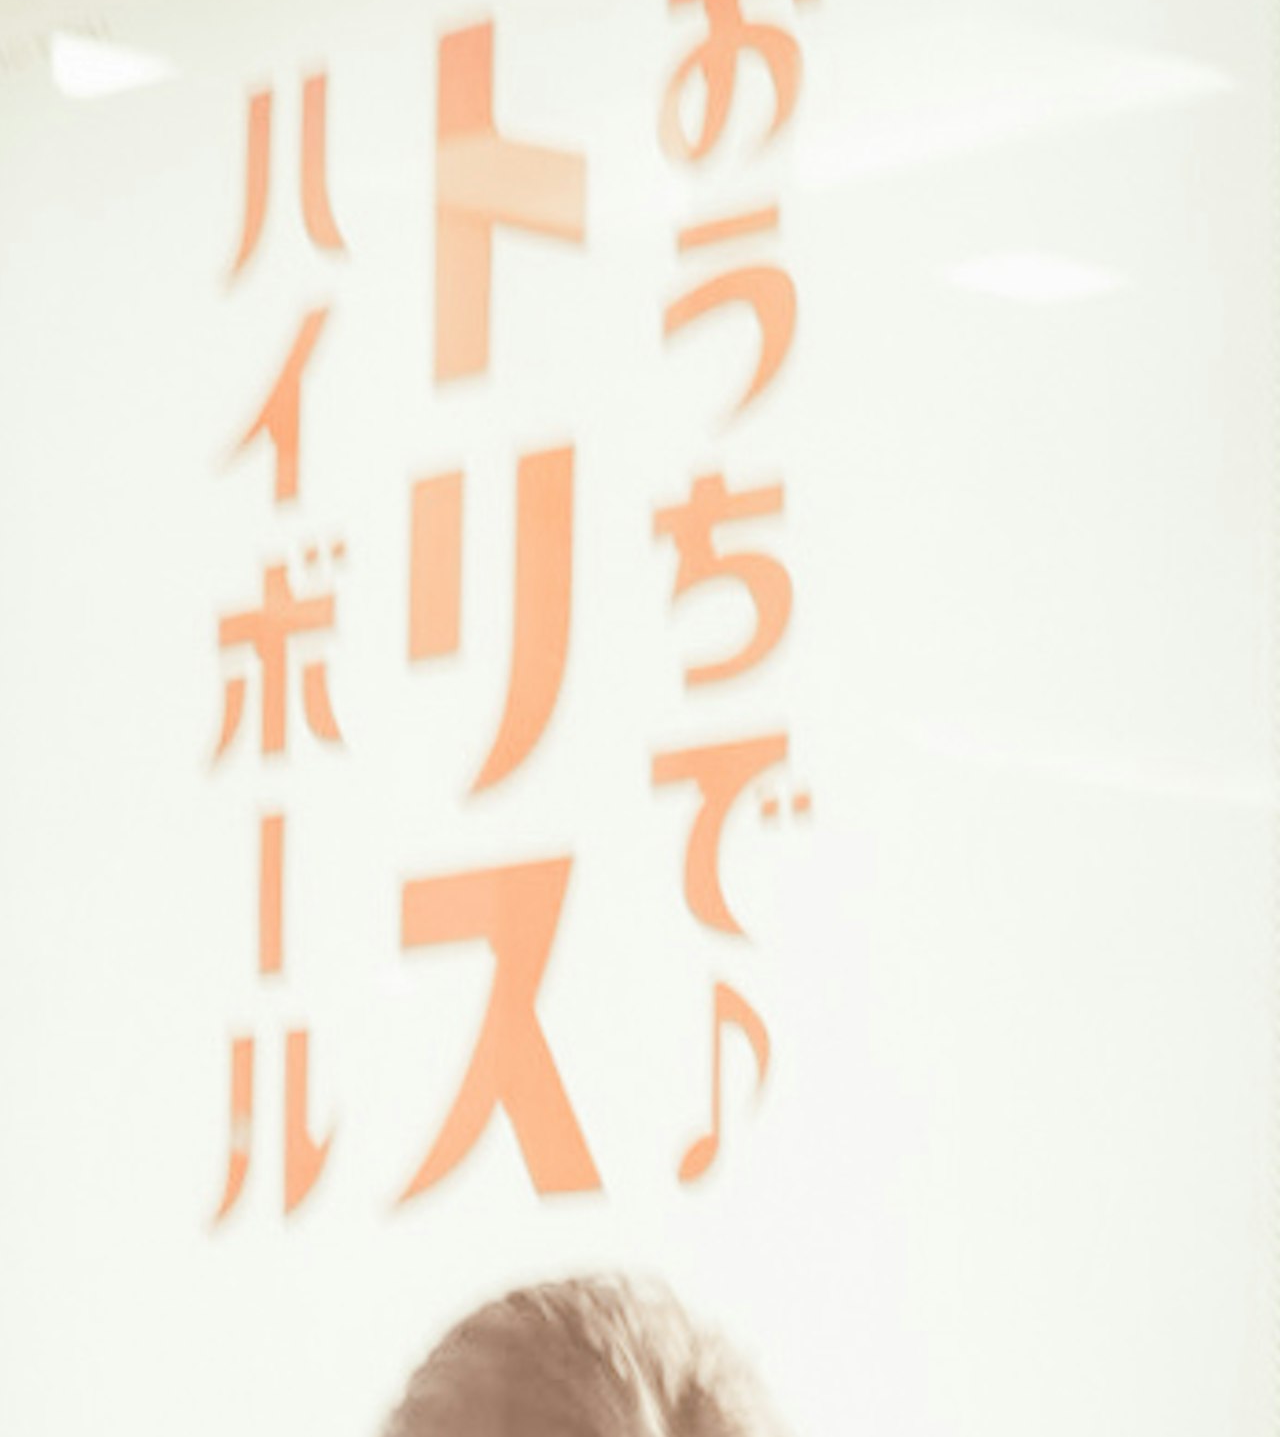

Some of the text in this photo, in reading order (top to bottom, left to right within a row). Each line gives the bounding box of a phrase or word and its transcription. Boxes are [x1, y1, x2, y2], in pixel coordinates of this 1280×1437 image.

[210, 68, 350, 1235] ハイボール
[388, 17, 606, 1213] トリス
